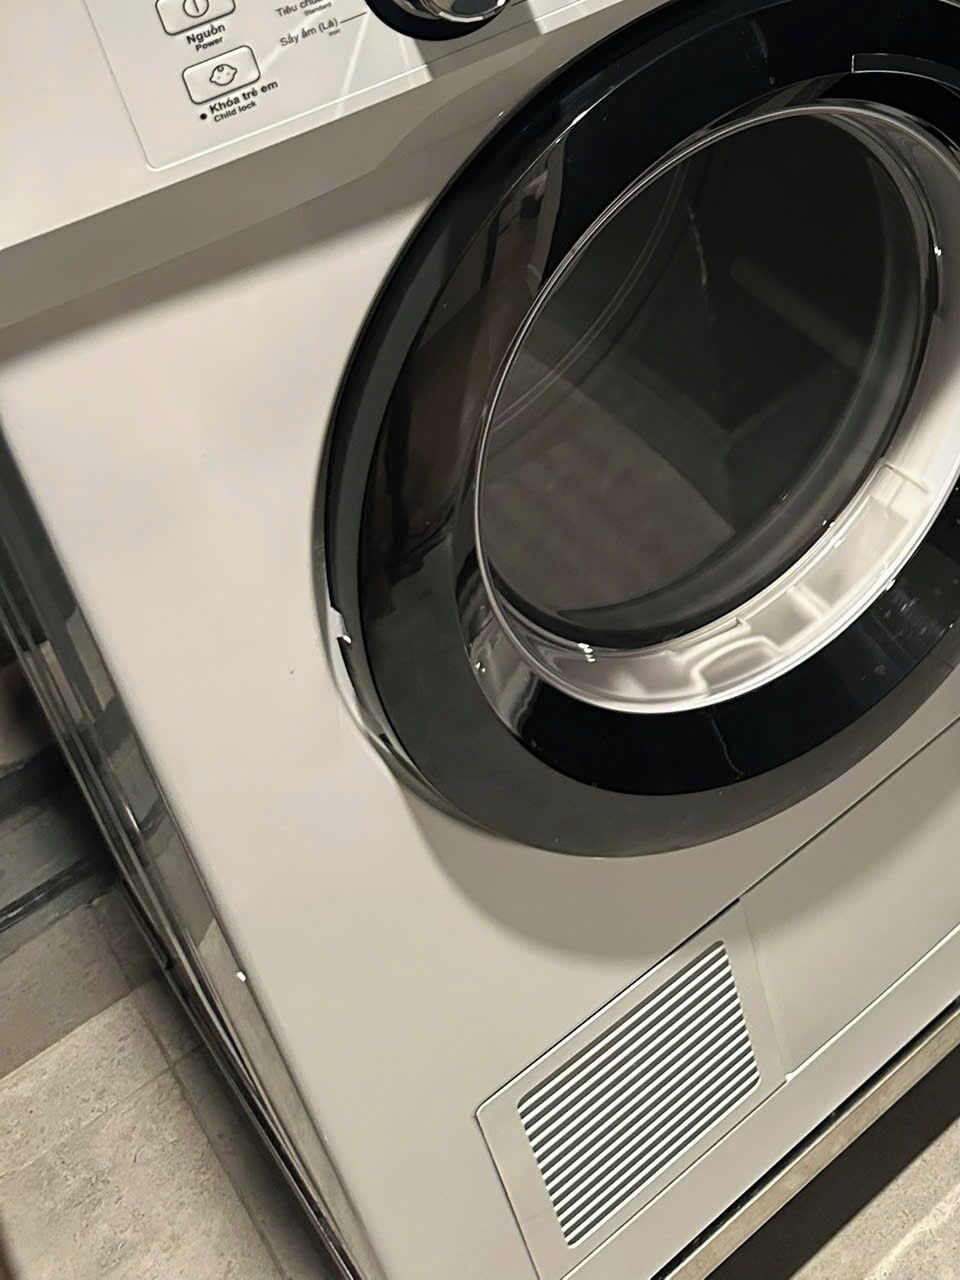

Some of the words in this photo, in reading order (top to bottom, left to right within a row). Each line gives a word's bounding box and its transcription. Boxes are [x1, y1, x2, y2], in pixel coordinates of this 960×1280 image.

[275, 4, 298, 17] Tiêu
[186, 23, 226, 44] Nguồn
[280, 32, 299, 47] Sấy
[195, 36, 223, 52] Power
[209, 96, 240, 114] Khóa
[242, 86, 259, 100] trẻ
[260, 80, 279, 93] em
[213, 107, 237, 123] Child
[238, 100, 257, 112] lock
